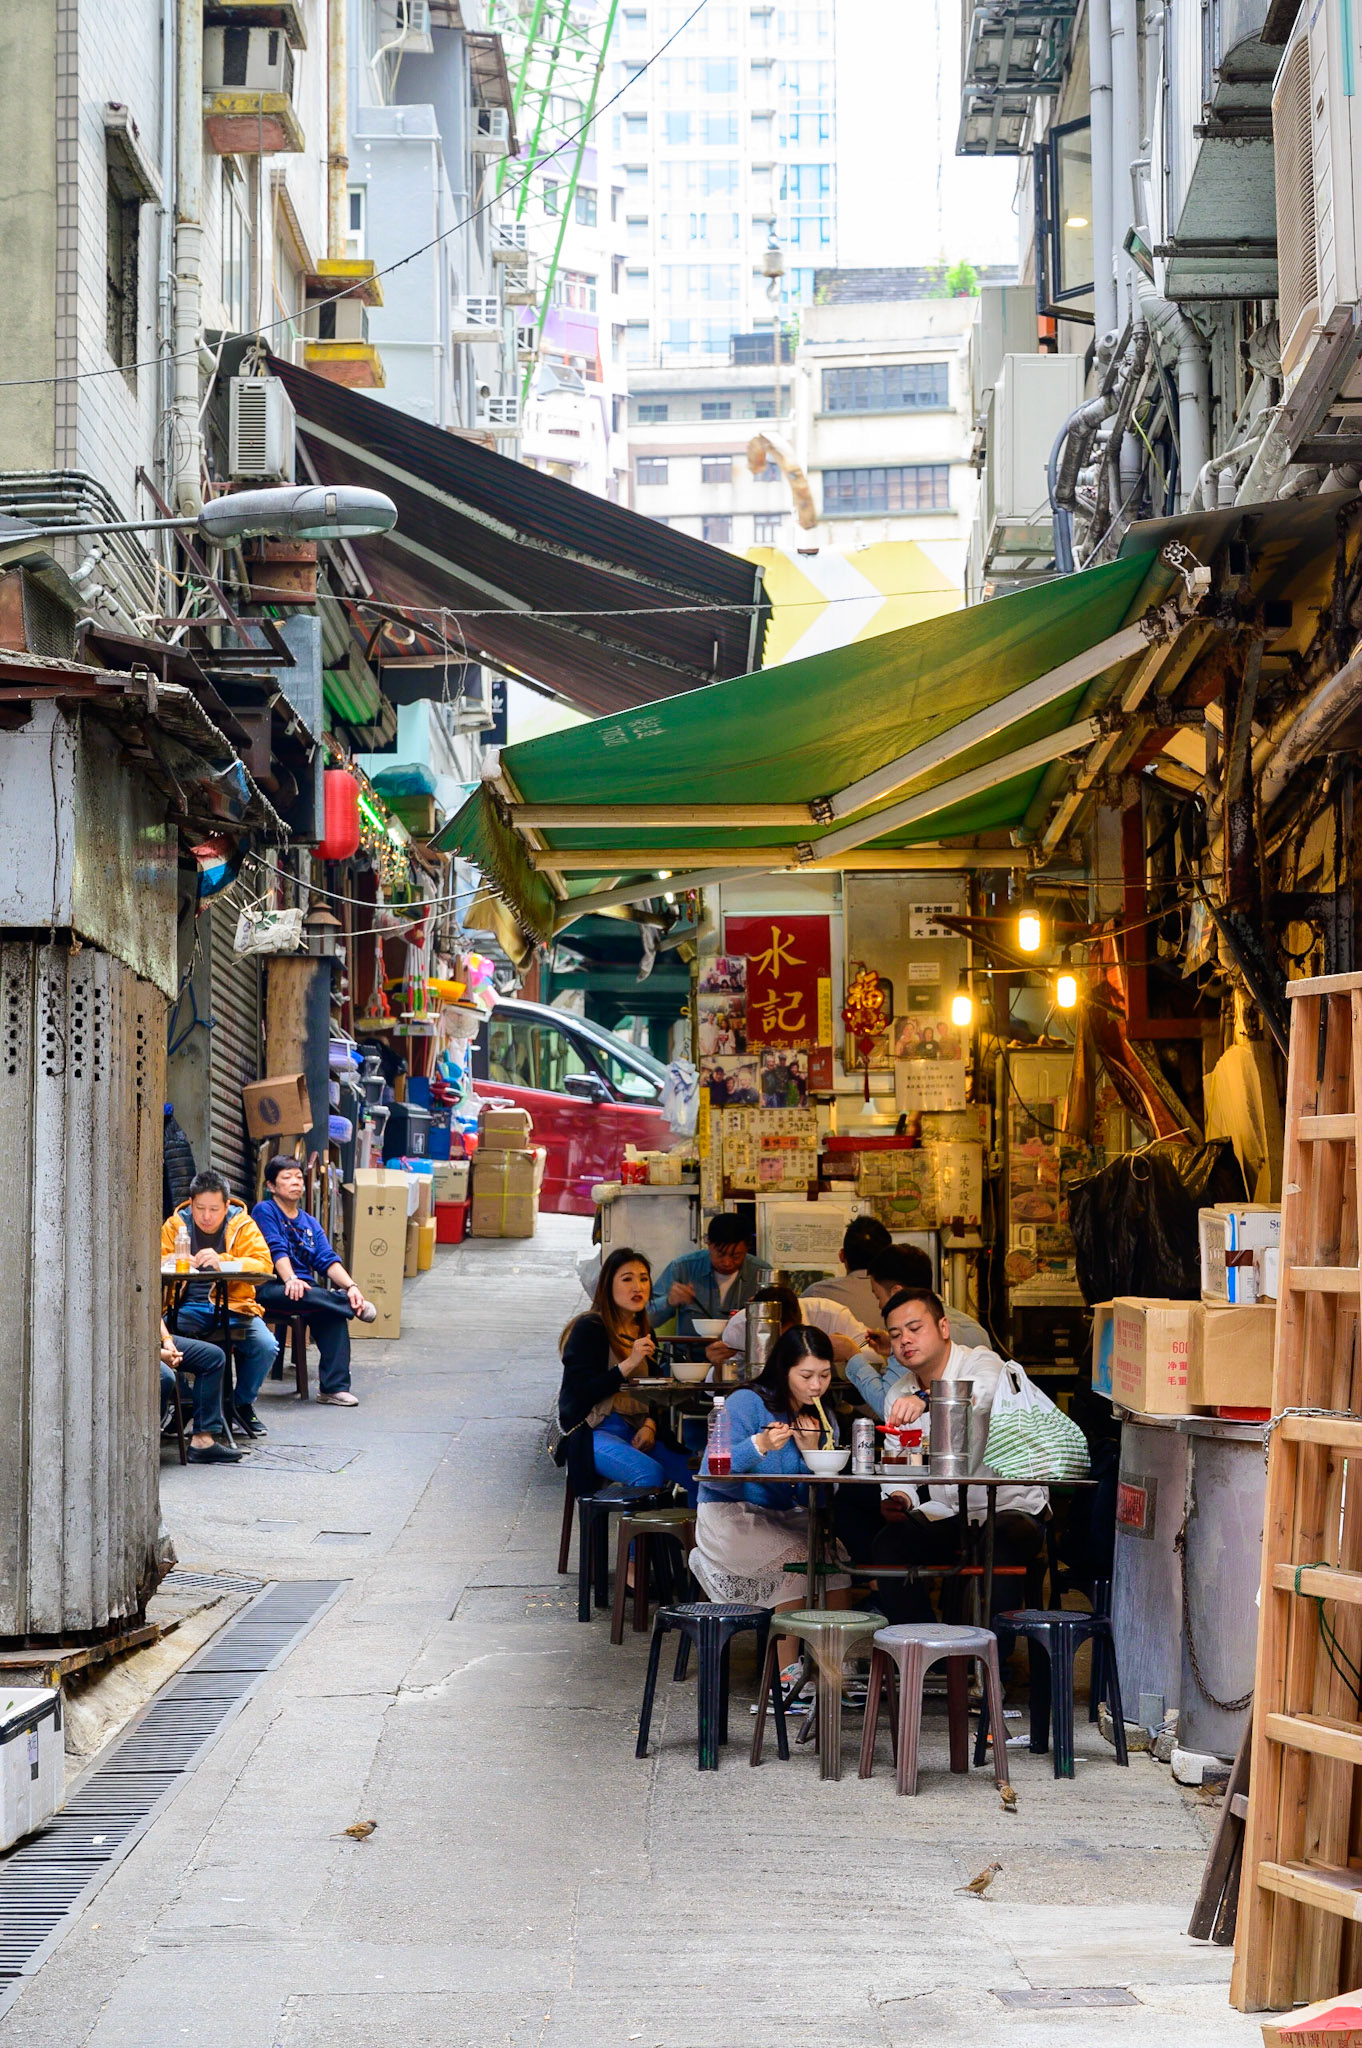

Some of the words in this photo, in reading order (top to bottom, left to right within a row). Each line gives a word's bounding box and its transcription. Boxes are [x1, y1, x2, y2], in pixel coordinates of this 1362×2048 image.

[749, 925, 807, 1034] 水記
[847, 970, 885, 1010] 福
[1167, 1376, 1188, 1386] 毛重
